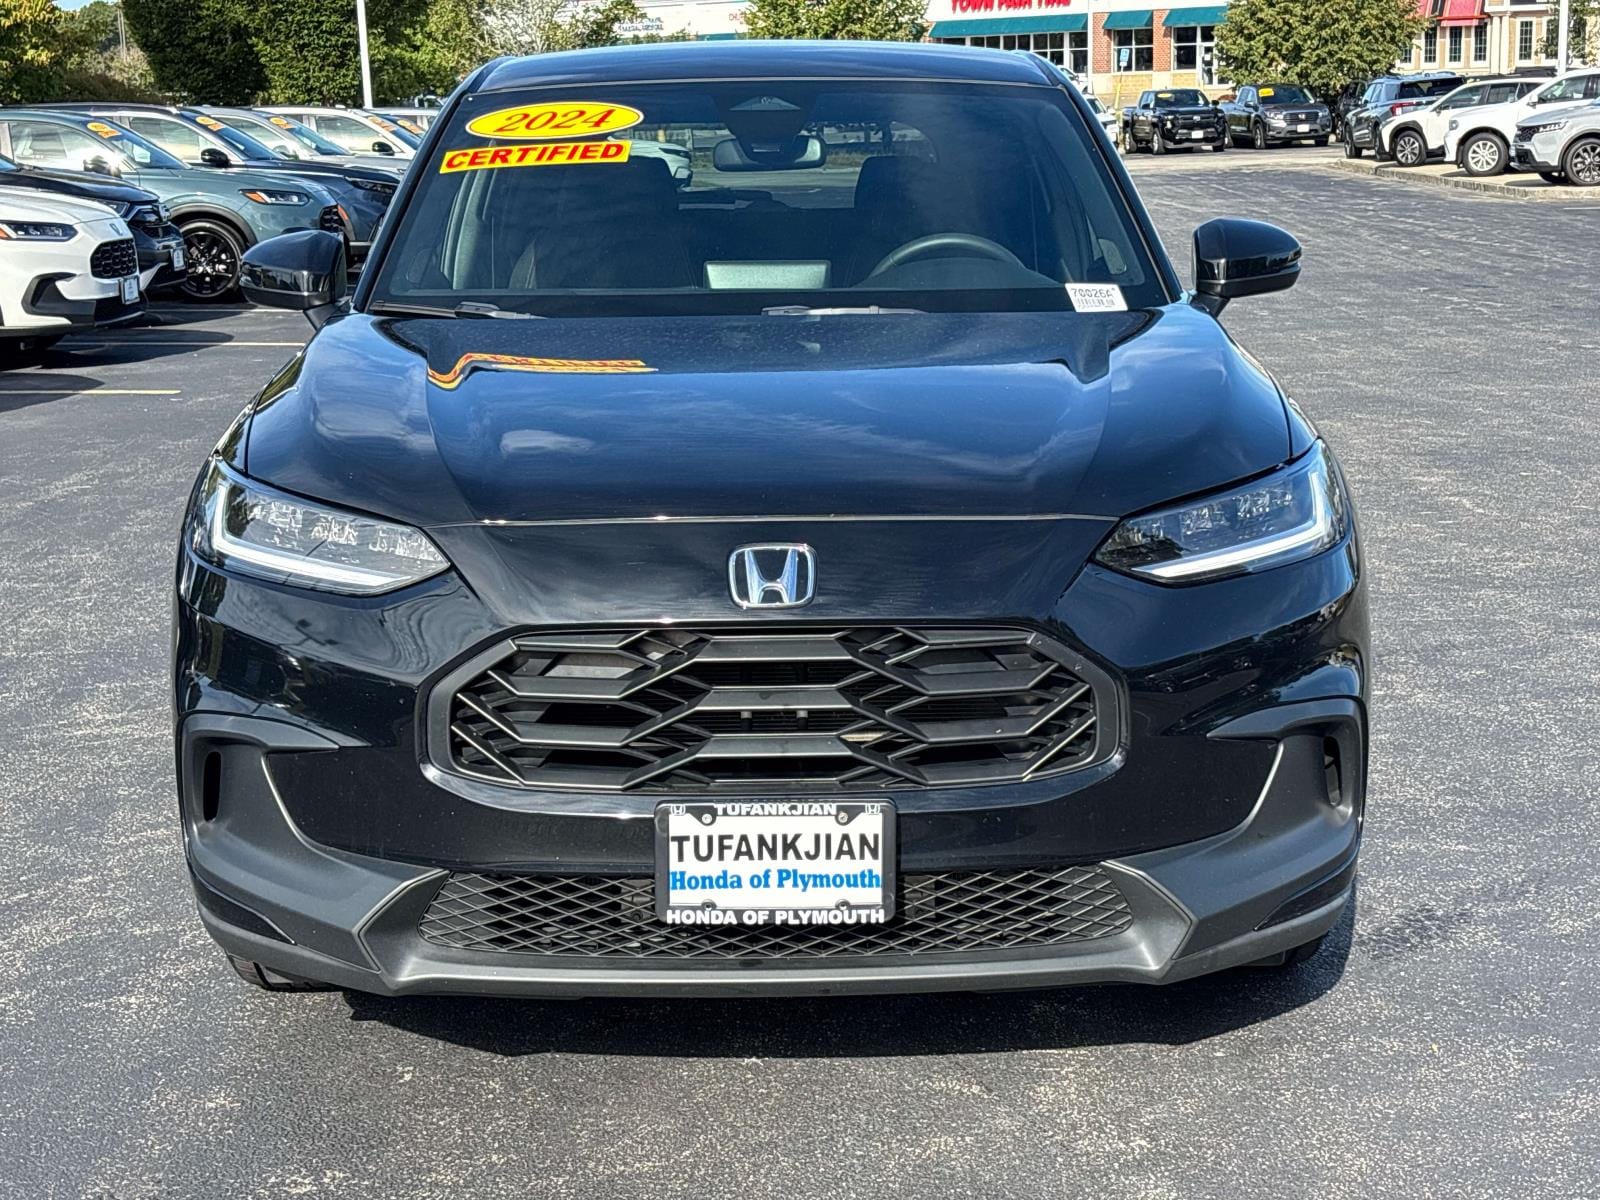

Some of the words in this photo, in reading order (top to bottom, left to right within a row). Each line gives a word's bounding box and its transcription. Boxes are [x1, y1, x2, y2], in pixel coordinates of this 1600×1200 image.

[494, 109, 616, 133] 2024
[446, 144, 624, 169] CERTIFIED
[714, 803, 837, 816] TUFANKJIAN
[670, 833, 880, 863] TUFANKJIAN
[670, 869, 743, 890] Honda
[749, 868, 772, 889] of
[776, 868, 881, 892] Plymouth
[666, 909, 737, 925] HONDA
[742, 910, 769, 925] OF
[774, 908, 885, 925] PLYMOUTH
